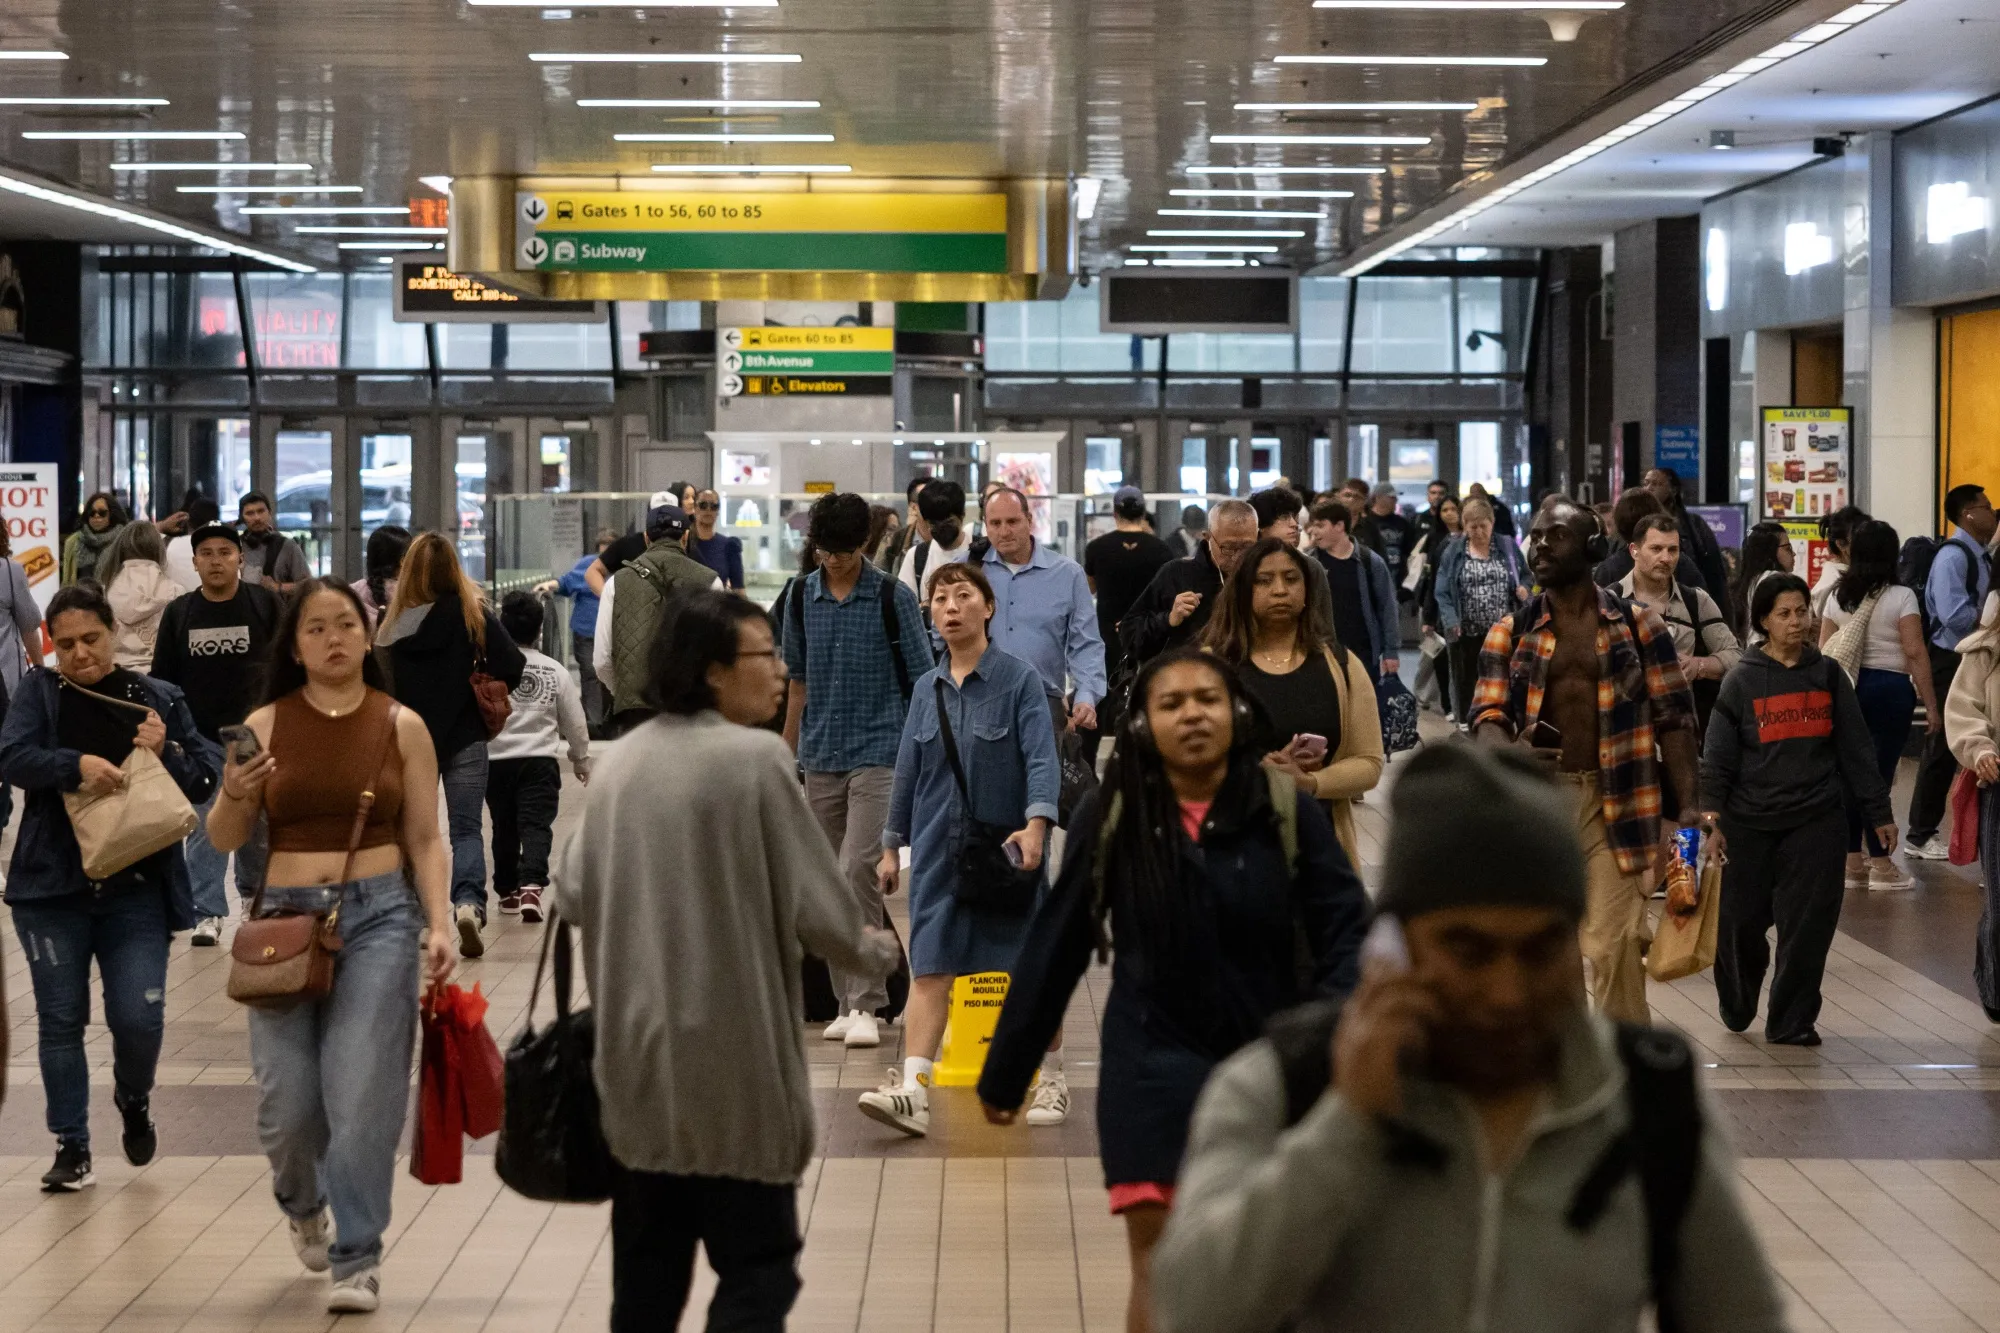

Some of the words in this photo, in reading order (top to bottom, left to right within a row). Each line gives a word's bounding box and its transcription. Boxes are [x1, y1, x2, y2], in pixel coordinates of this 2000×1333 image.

[582, 204, 627, 218] Gates
[634, 205, 641, 217] 1
[648, 205, 664, 218] to
[669, 205, 692, 219] 56,
[698, 205, 716, 218] 60
[722, 206, 738, 218] to
[743, 205, 762, 218] 85
[581, 244, 647, 262] Subway
[408, 278, 471, 290] SOMETHING
[453, 289, 480, 301] CALL
[257, 310, 337, 334] UALITY
[768, 333, 800, 344] Gates
[806, 333, 820, 344] 60
[824, 334, 836, 344] to
[840, 333, 854, 344] 85
[745, 356, 767, 367] 8th
[768, 356, 814, 367] Avenue
[788, 379, 846, 392] Elevators
[1783, 409, 1807, 418] SAVE
[7, 517, 49, 538] OG
[190, 637, 250, 657] KORS
[969, 976, 1008, 985] PLANCHER
[972, 985, 1005, 995] MOUILLÉ
[964, 999, 981, 1008] PISO
